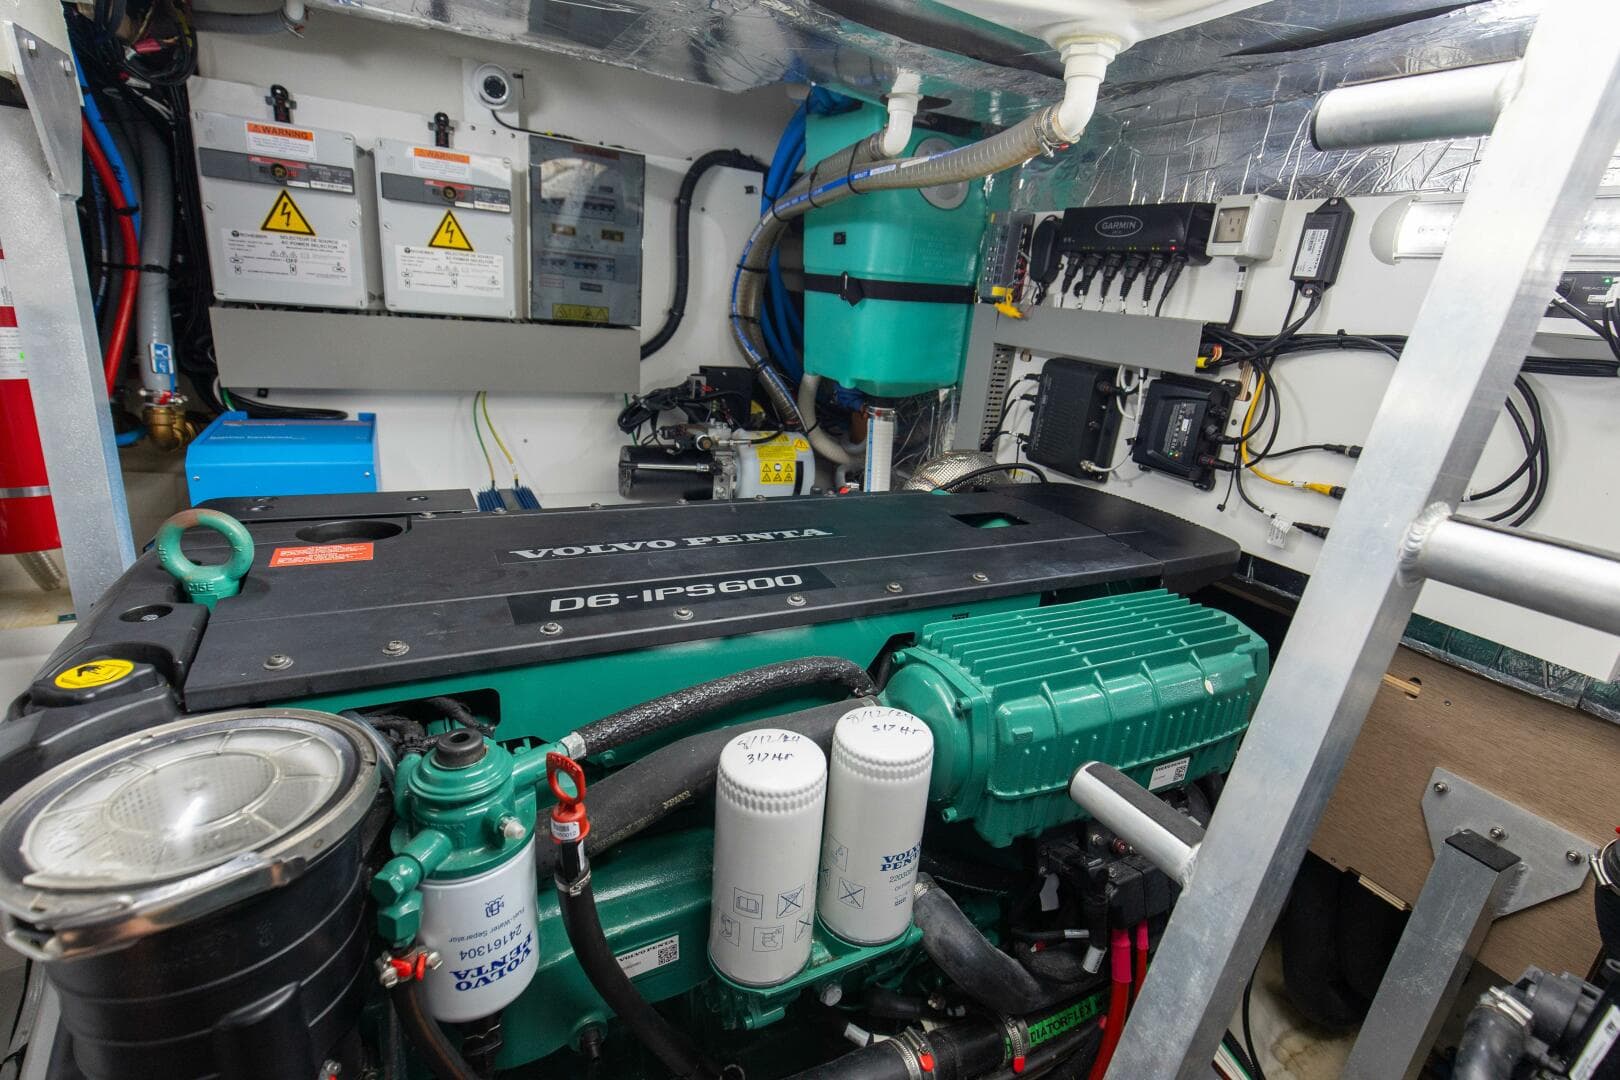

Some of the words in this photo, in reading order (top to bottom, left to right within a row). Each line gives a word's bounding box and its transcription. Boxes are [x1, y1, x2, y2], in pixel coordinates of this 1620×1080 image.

[262, 126, 307, 139] WARNING
[1101, 221, 1137, 230] GARMIN
[509, 540, 677, 559] VOLVO
[682, 528, 832, 547] PENTA
[449, 930, 489, 943] Separator
[459, 923, 522, 960] 24161304
[449, 930, 532, 981] PENTA
[619, 949, 646, 962] VOLVO
[646, 940, 674, 952] PENTA
[455, 948, 532, 991] VOLVO
